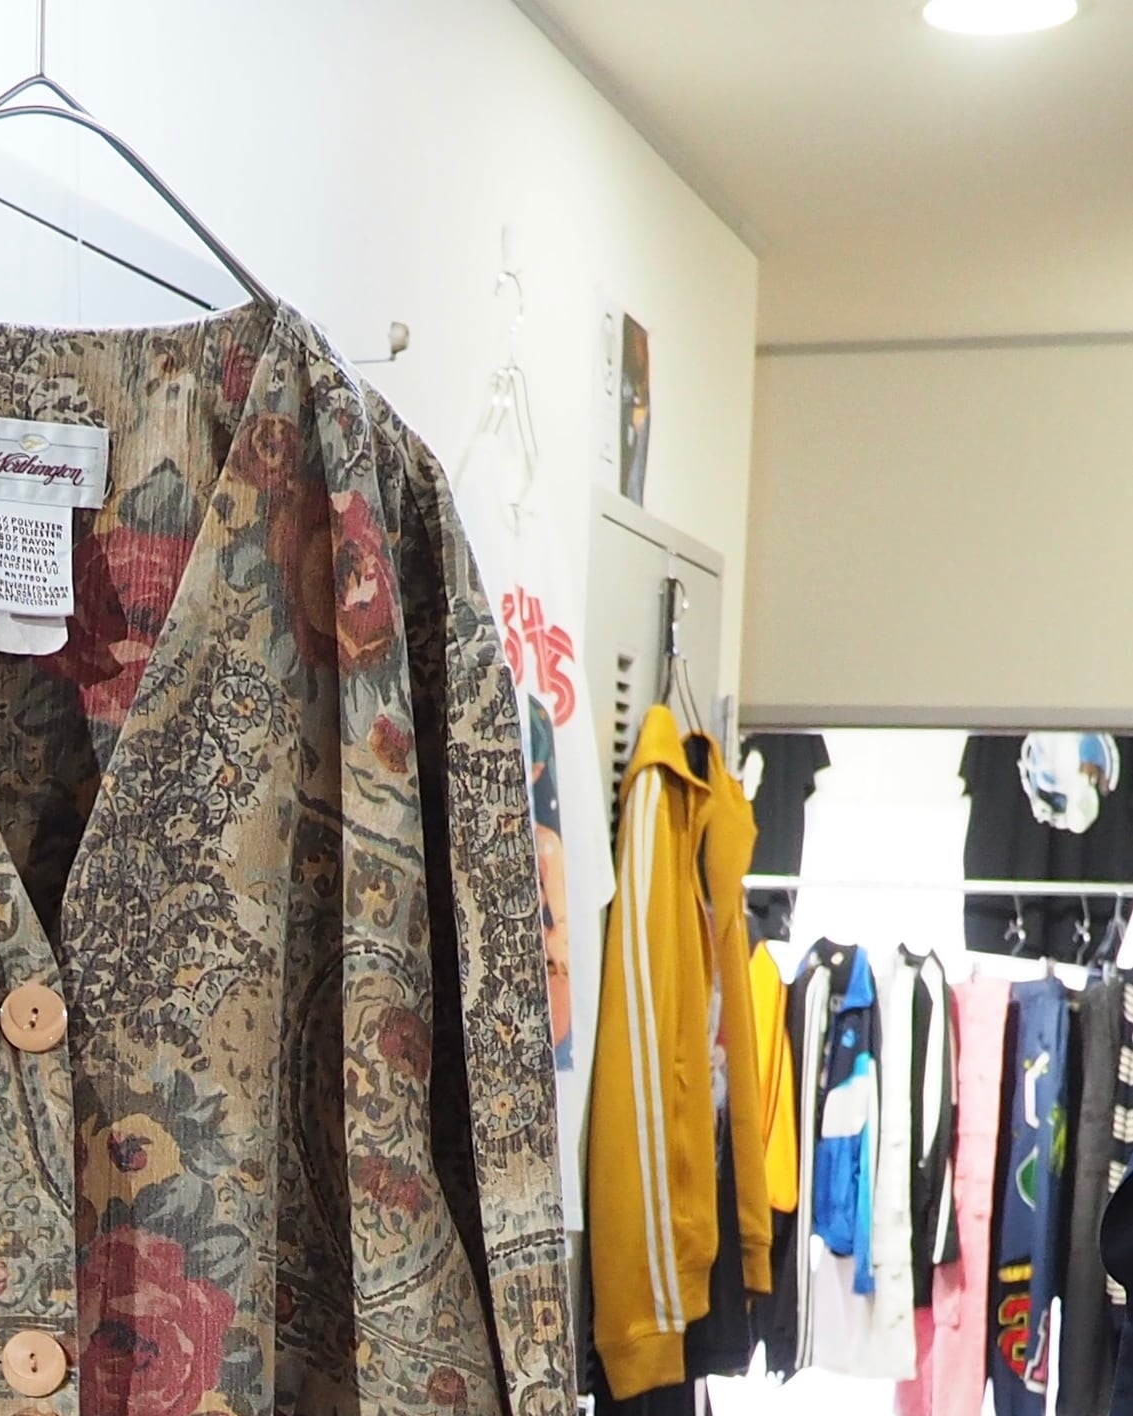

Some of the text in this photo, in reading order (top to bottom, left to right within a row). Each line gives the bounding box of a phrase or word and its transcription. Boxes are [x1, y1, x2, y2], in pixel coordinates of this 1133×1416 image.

[11, 516, 63, 531] POLYESTER
[12, 526, 62, 540] POLIESTER
[21, 537, 55, 548] RAYON
[21, 546, 55, 557] RAYON
